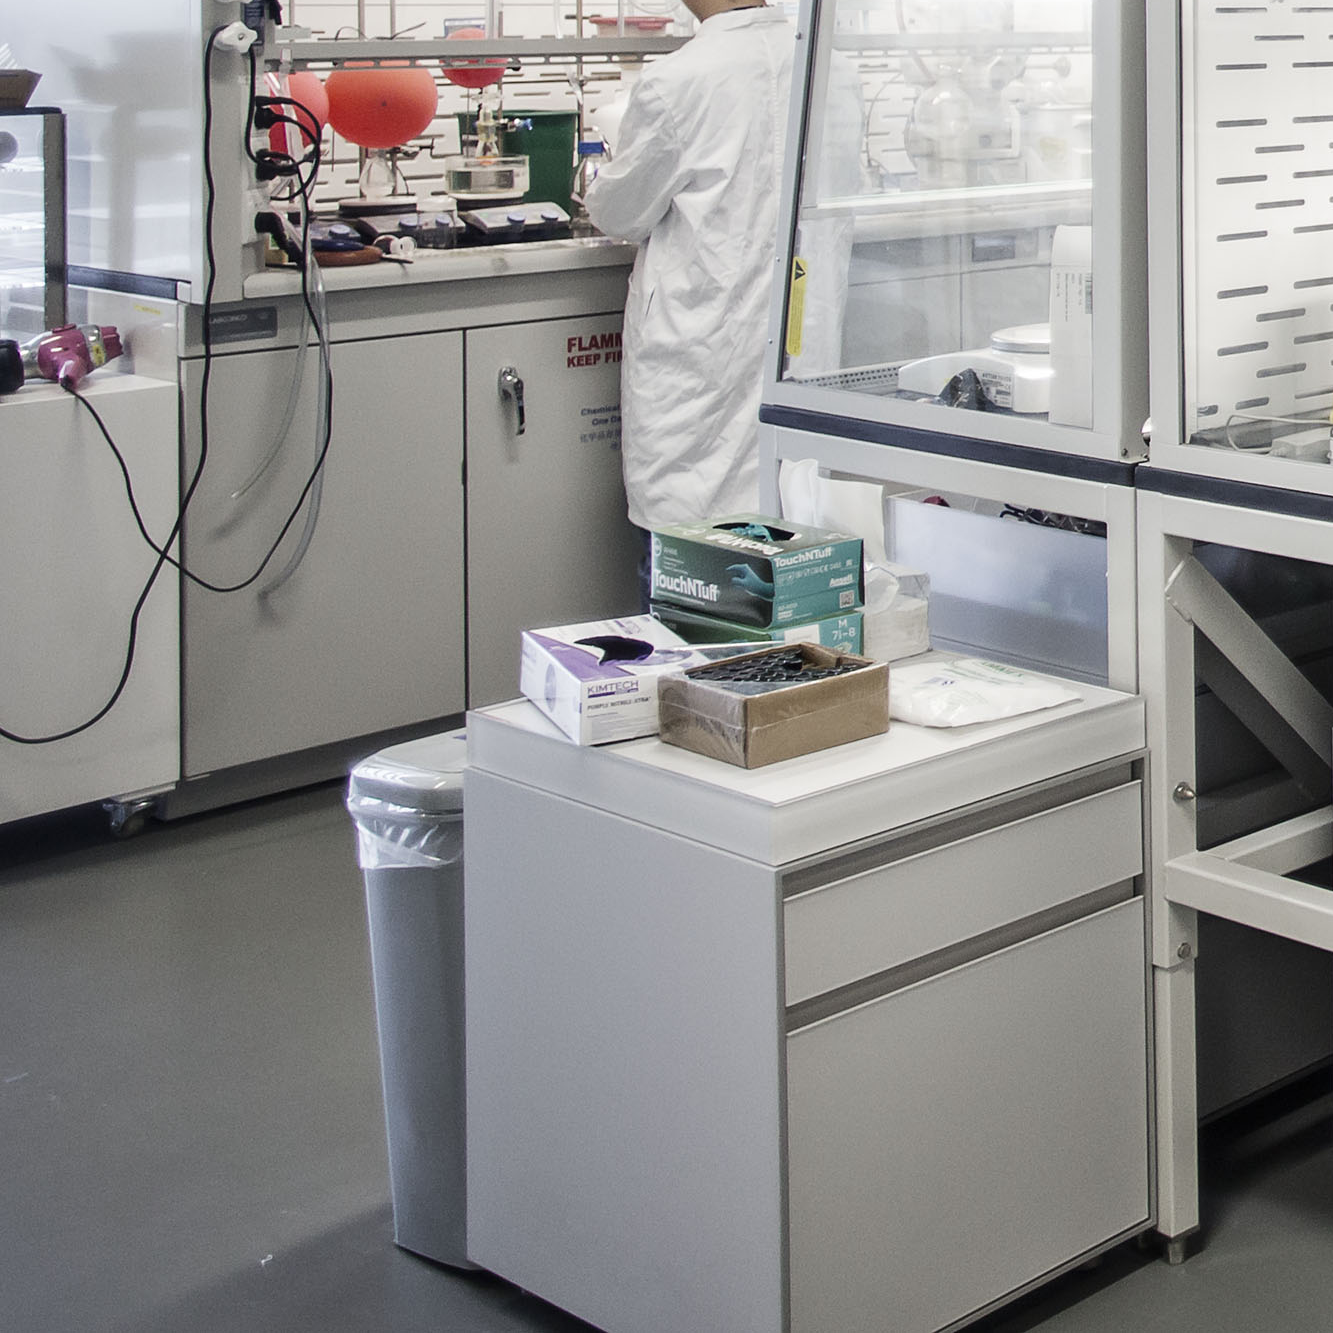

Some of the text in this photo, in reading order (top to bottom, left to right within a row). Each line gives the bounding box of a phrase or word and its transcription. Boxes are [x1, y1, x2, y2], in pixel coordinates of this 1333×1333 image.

[567, 353, 601, 368] KEEP
[774, 546, 832, 568] TouchNTuff
[654, 569, 718, 602] TouchNTuff
[587, 680, 639, 695] KIMTECH
